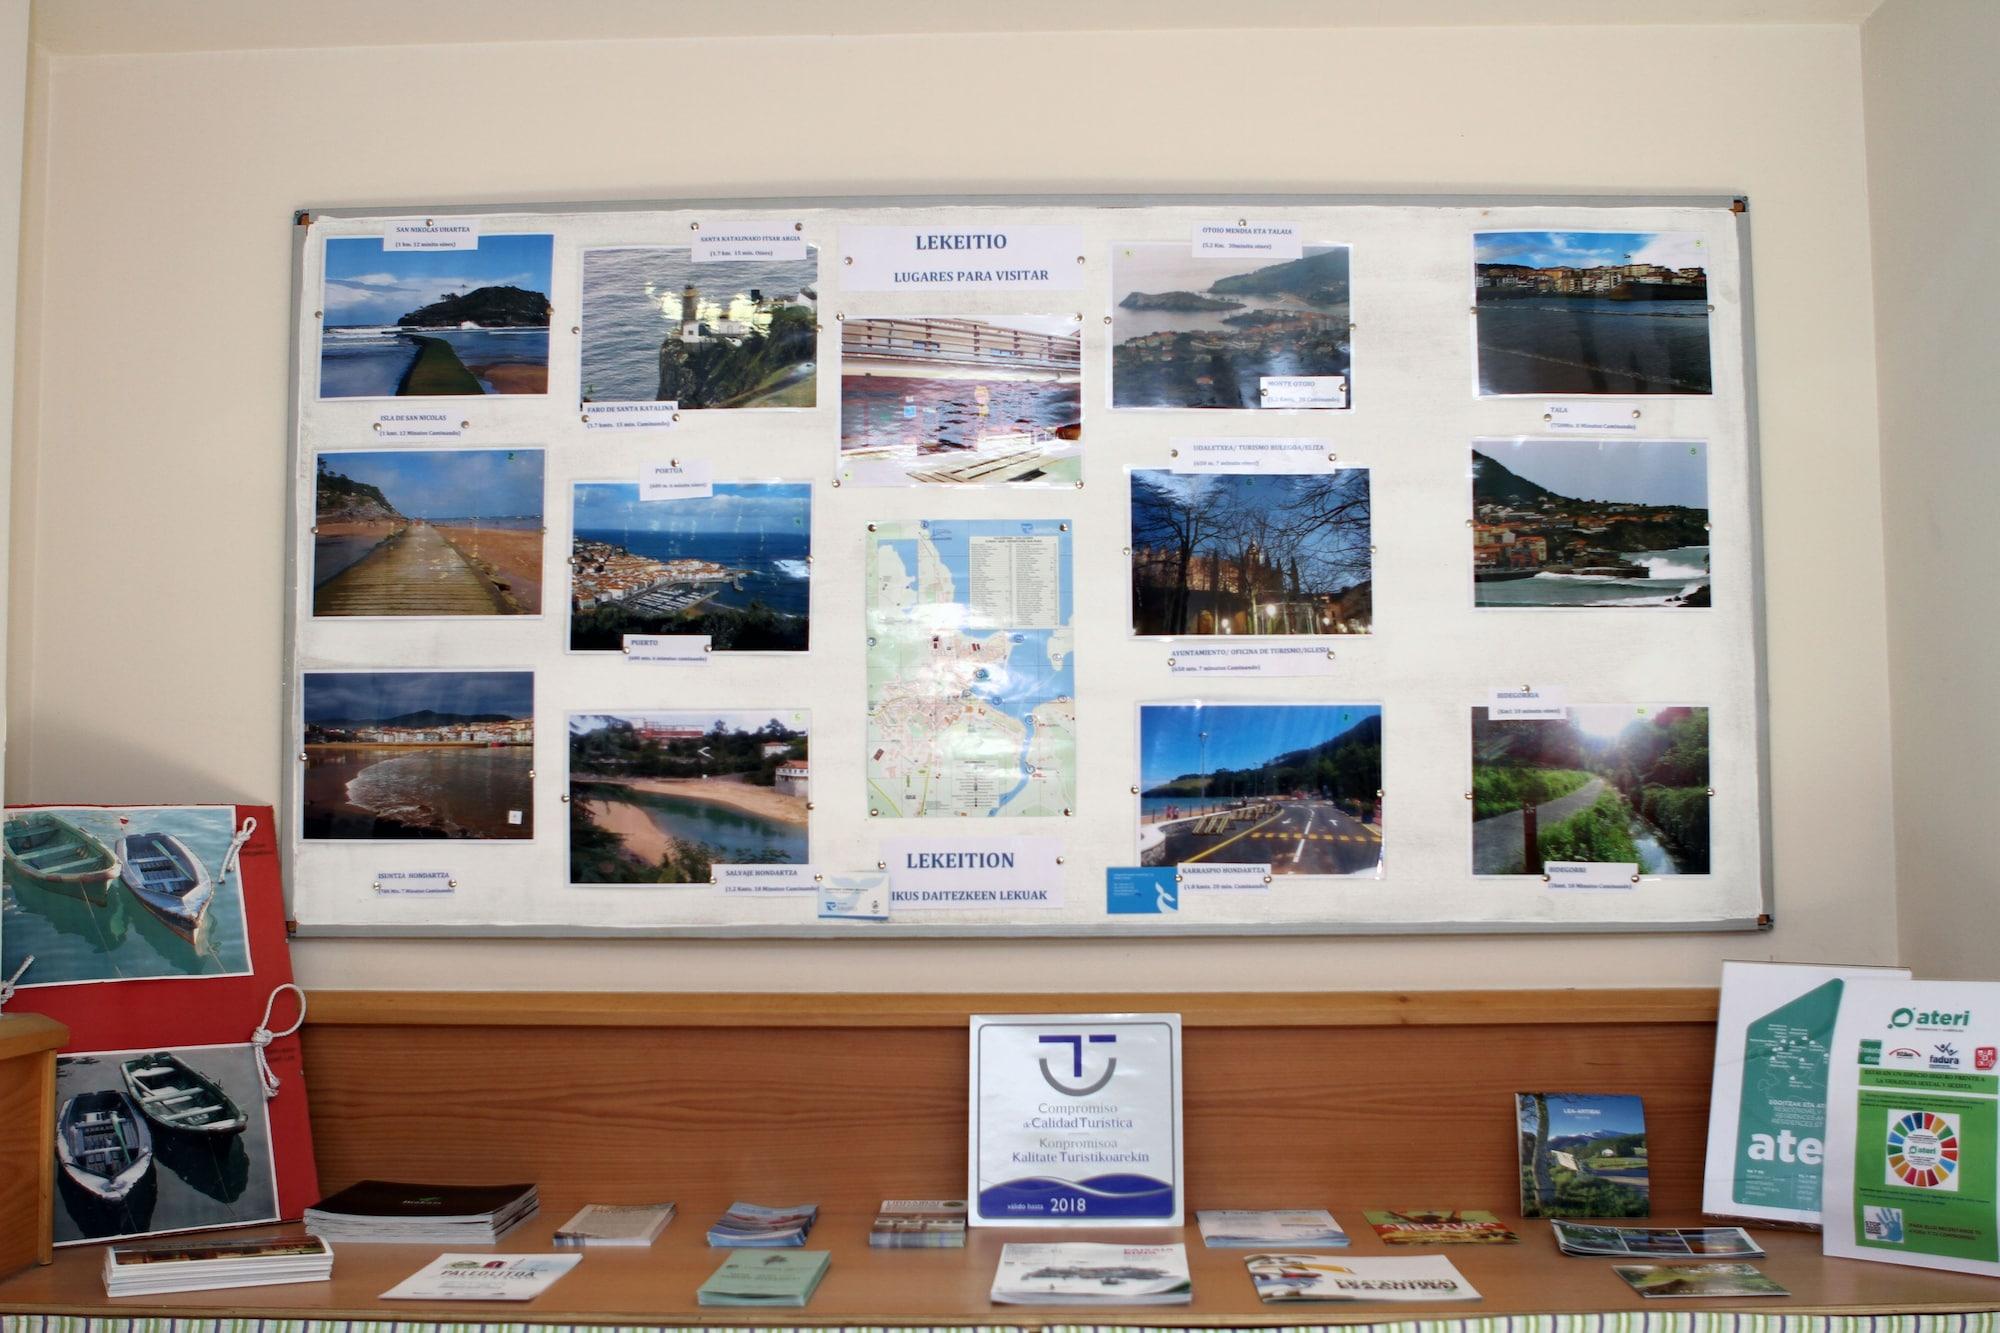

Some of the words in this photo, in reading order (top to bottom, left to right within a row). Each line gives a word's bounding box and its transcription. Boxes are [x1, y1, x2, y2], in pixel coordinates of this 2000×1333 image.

[916, 234, 1007, 250] LEKEITIO
[894, 272, 953, 282] LUGARES
[957, 271, 992, 282] PARA
[996, 270, 1049, 281] VISITAR
[907, 853, 1014, 868] LEKEITION
[892, 891, 919, 901] IKUS
[922, 891, 996, 900] DAITEZKEEN
[1000, 890, 1047, 900] LEKUAK
[1916, 1010, 1970, 1026] ateri
[1930, 1055, 1959, 1065] fadura
[1038, 1103, 1118, 1116] Compromiso
[1032, 1117, 1078, 1129] Calidad
[1039, 1138, 1117, 1150] Konpromisoa
[1012, 1151, 1057, 1163] Kalitate
[1061, 1151, 1149, 1163] Turistikoarekin
[1050, 1198, 1086, 1212] 2018
